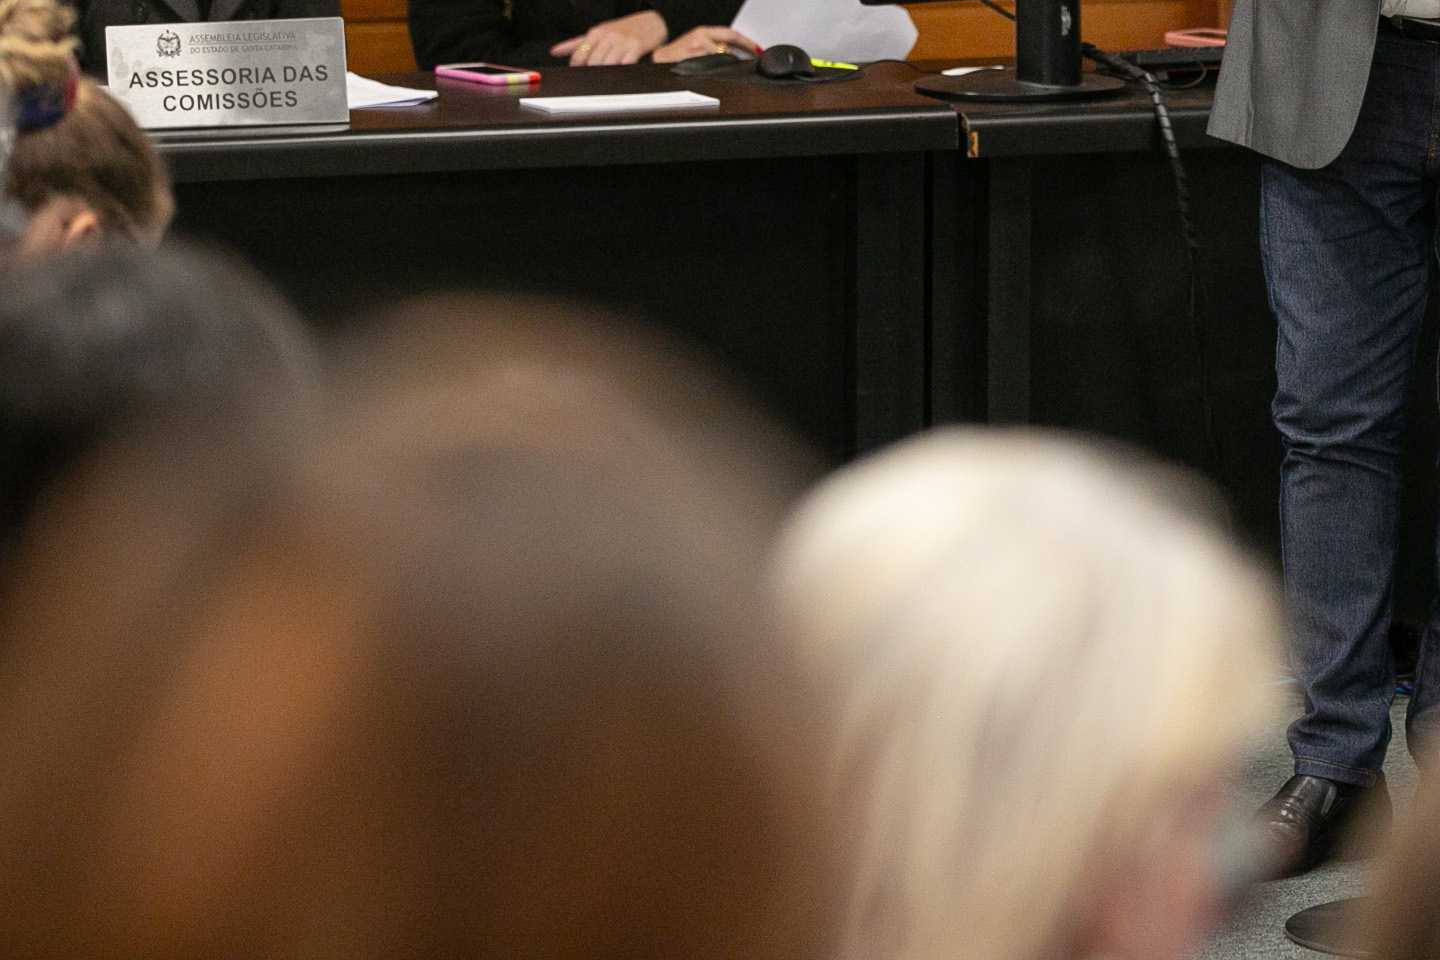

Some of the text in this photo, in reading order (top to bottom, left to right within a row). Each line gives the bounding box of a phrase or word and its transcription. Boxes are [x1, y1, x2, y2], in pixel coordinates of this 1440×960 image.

[189, 31, 296, 43] ASSEMBLEIA LEGISLATIVA
[202, 45, 229, 54] ESTADO
[230, 45, 239, 53] DE
[242, 44, 262, 52] SANTA
[264, 43, 298, 52] CATARINA
[129, 64, 329, 89] ASSESSORIA DAS
[162, 88, 299, 112] COMISSÕES
